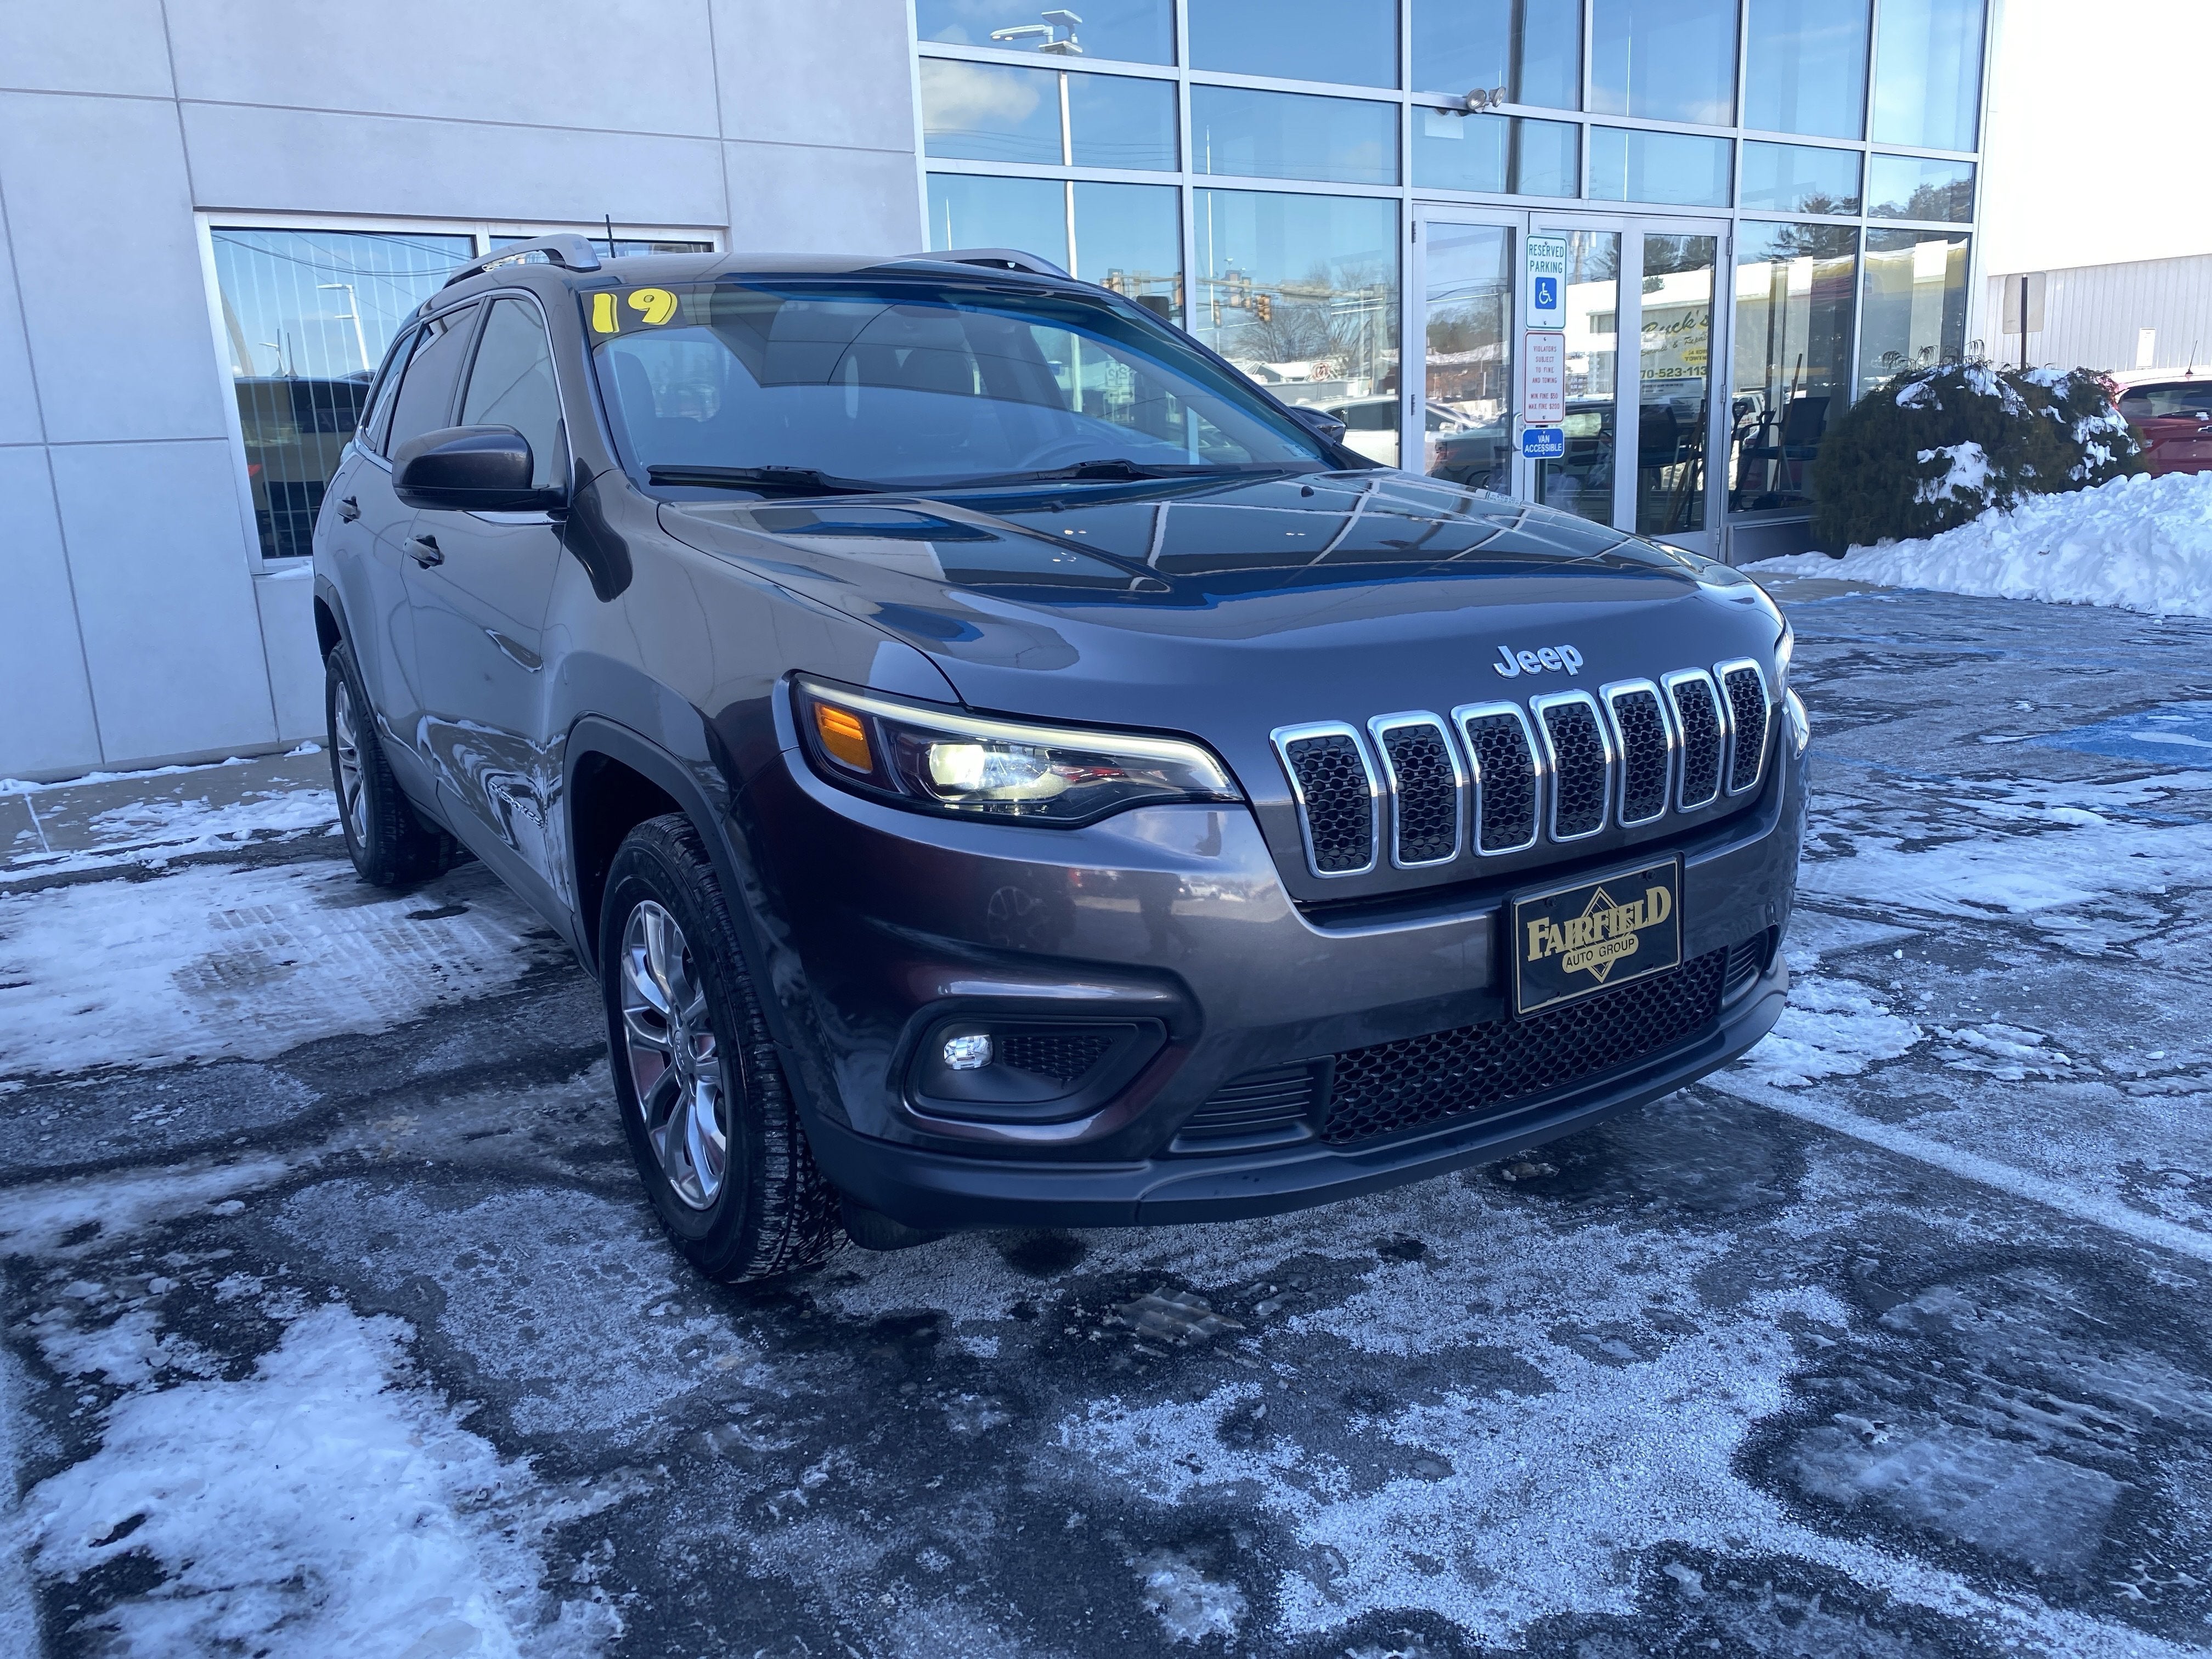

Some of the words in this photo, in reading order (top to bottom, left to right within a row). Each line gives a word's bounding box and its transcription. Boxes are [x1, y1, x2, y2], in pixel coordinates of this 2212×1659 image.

[1529, 244, 1564, 257] RESERVED
[1530, 260, 1562, 273] PARKING
[592, 288, 678, 333] 19
[1524, 443, 1562, 453] ACCESSIBLE
[1538, 435, 1550, 443] VAN
[1492, 645, 1583, 679] Jeep
[1527, 886, 1672, 962] FAIRFIELD
[1566, 951, 1593, 968] AUTO
[1599, 938, 1634, 957] GROUP
